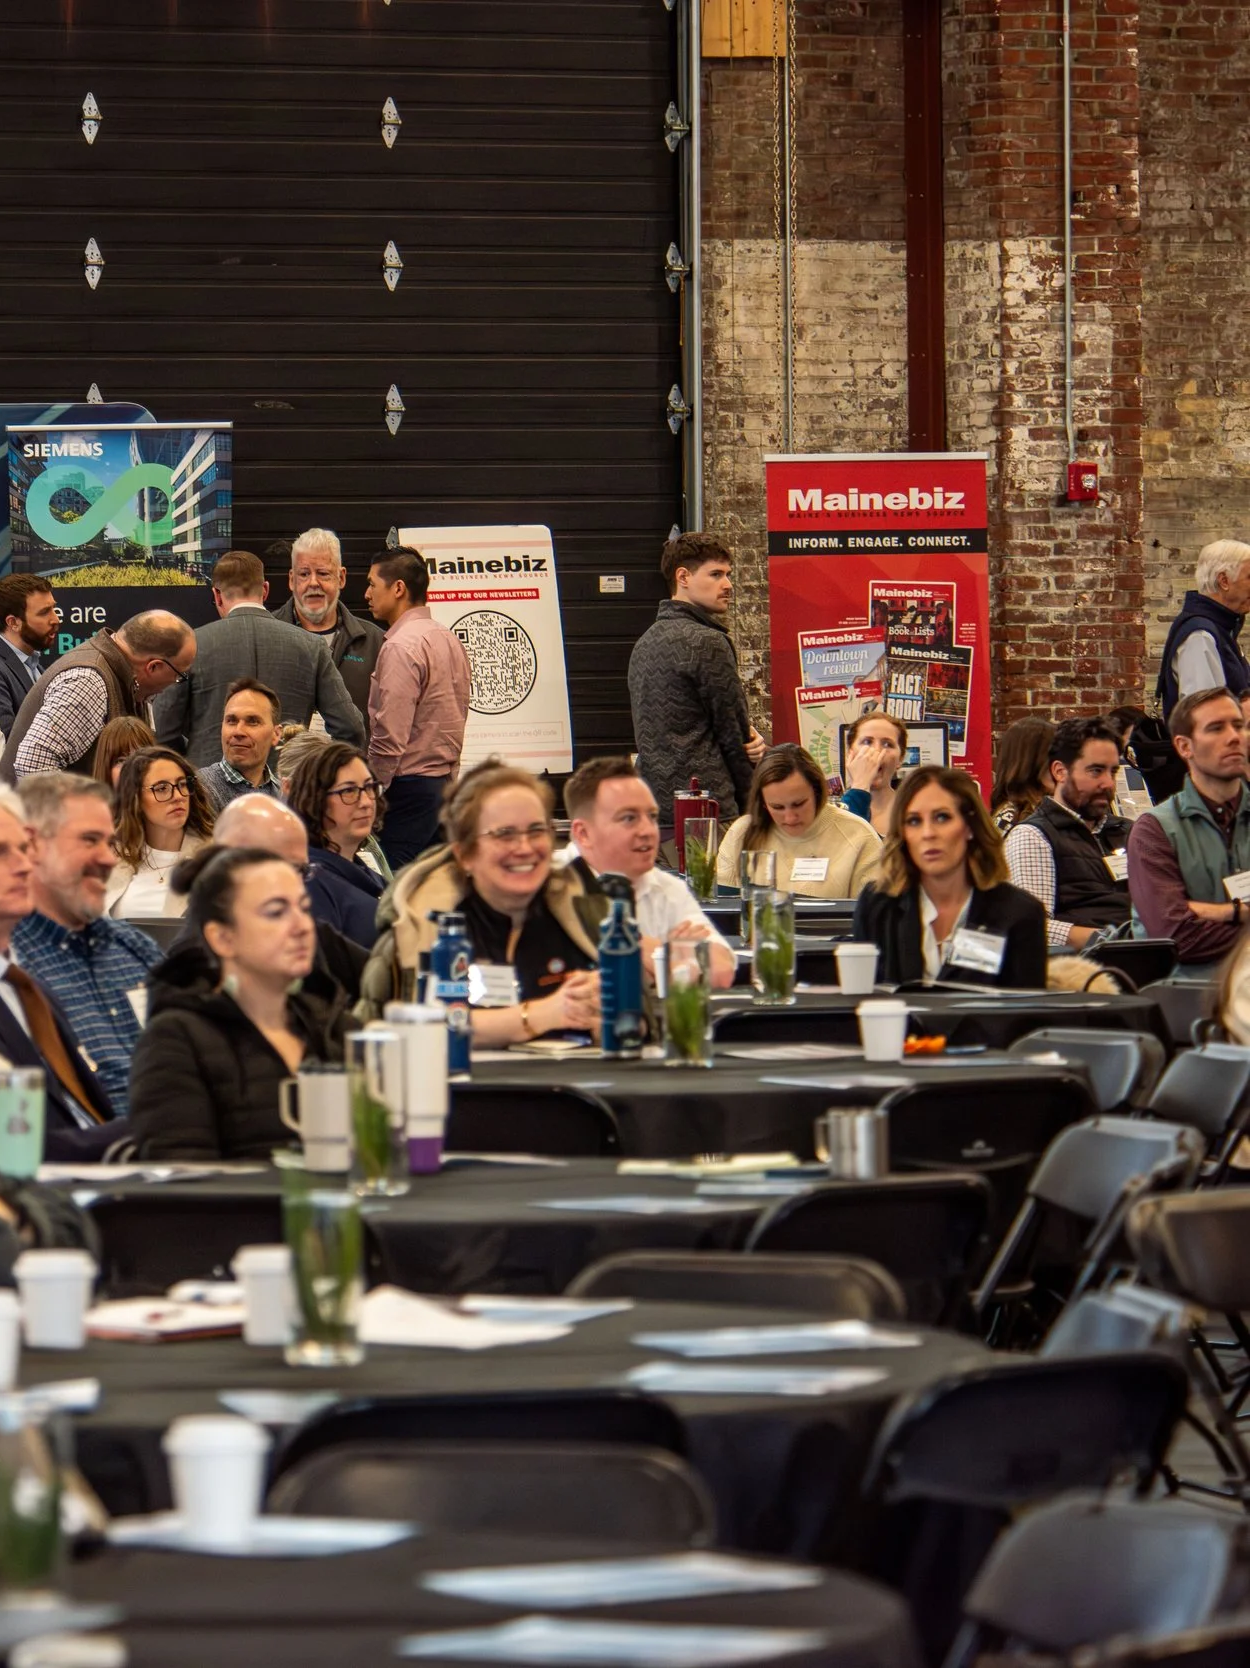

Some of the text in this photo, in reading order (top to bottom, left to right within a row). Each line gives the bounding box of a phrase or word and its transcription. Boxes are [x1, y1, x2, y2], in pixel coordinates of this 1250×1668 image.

[24, 443, 103, 457] SIEMENS
[788, 487, 965, 511] Mainebiz
[788, 536, 971, 549] INFORM. ENGAGE. CONNECT.
[490, 590, 537, 598] NEWSLETTERS
[874, 588, 933, 598] Mainebiz
[70, 607, 106, 623] are
[889, 627, 910, 636] Book
[914, 627, 935, 637] Lists
[803, 633, 864, 646] Mainebiz
[804, 649, 869, 665] Downtown
[891, 646, 949, 660] Mainebiz
[823, 661, 864, 675] revival
[891, 673, 922, 695] FACT
[800, 687, 861, 701] Mainebz
[887, 699, 922, 721] BOOK
